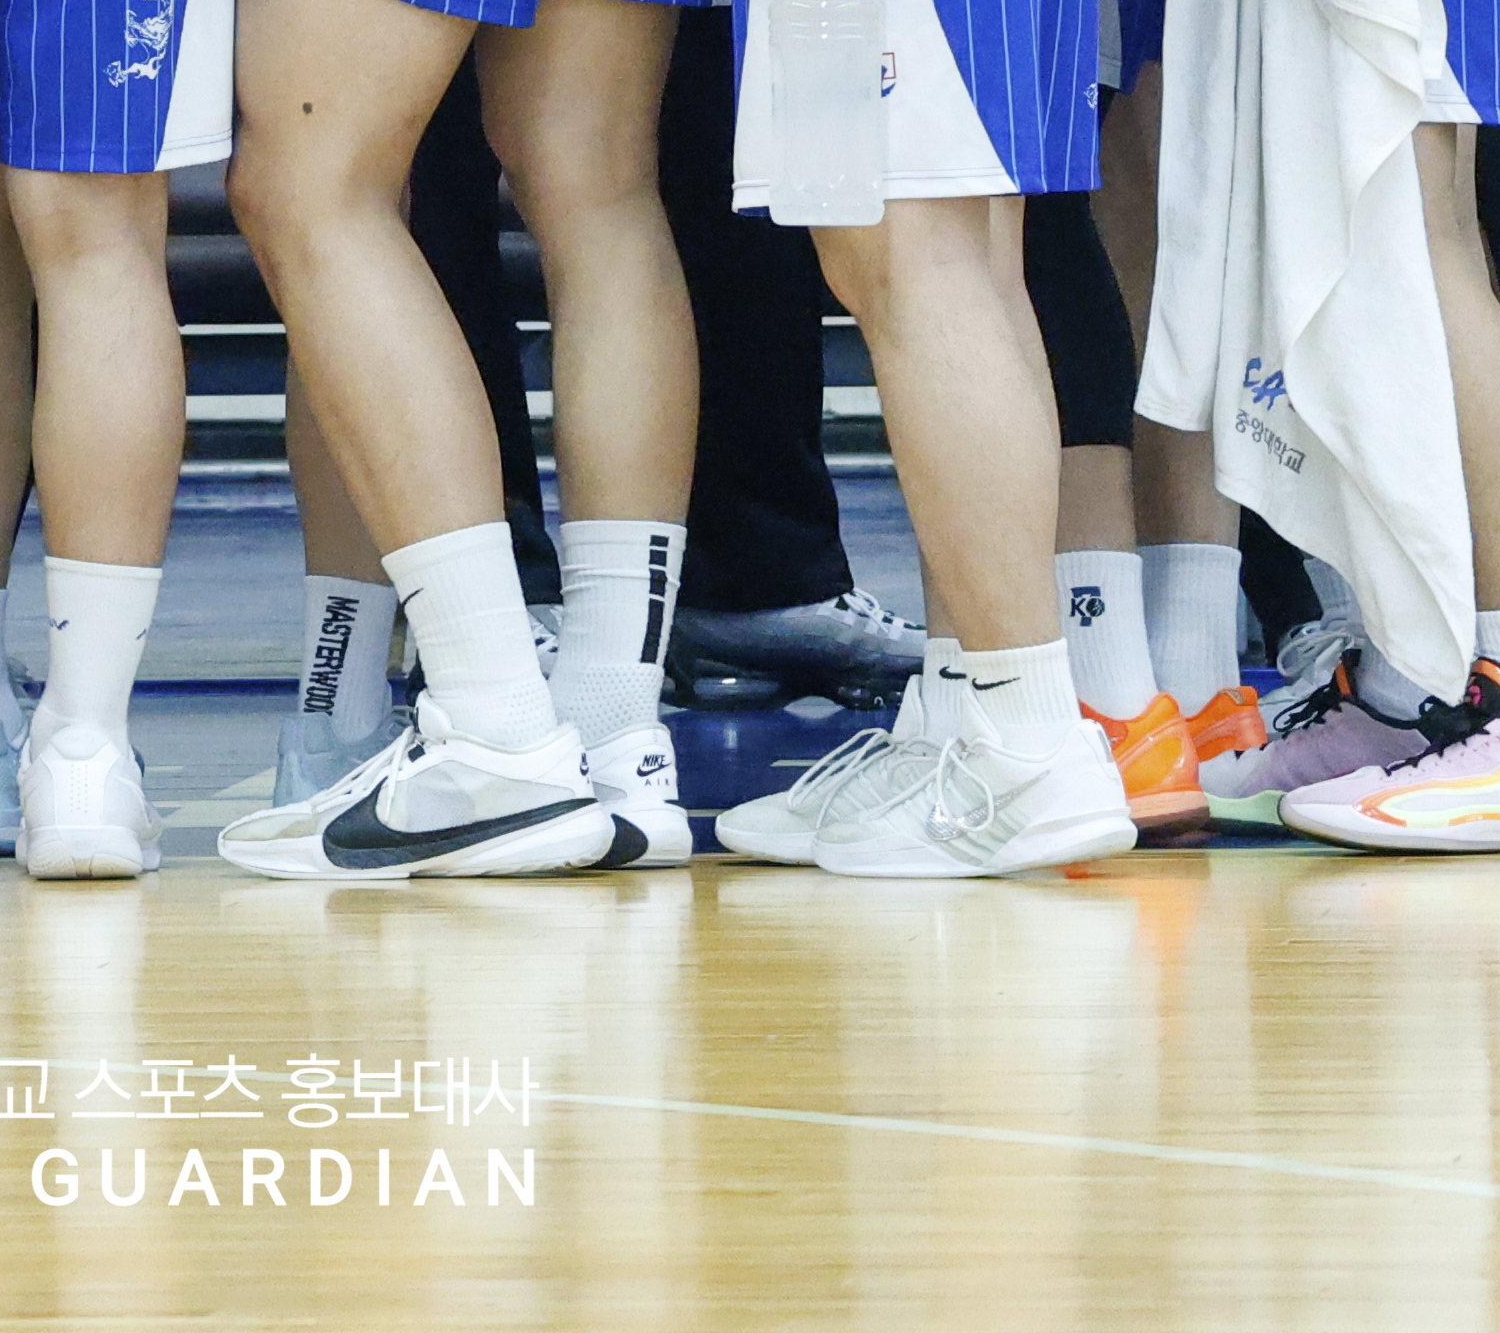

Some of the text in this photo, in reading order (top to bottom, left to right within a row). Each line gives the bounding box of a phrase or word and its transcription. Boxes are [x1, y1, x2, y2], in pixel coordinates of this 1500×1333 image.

[1243, 357, 1288, 411] CA
[641, 754, 667, 767] NIKE
[644, 778, 670, 787] AIR
